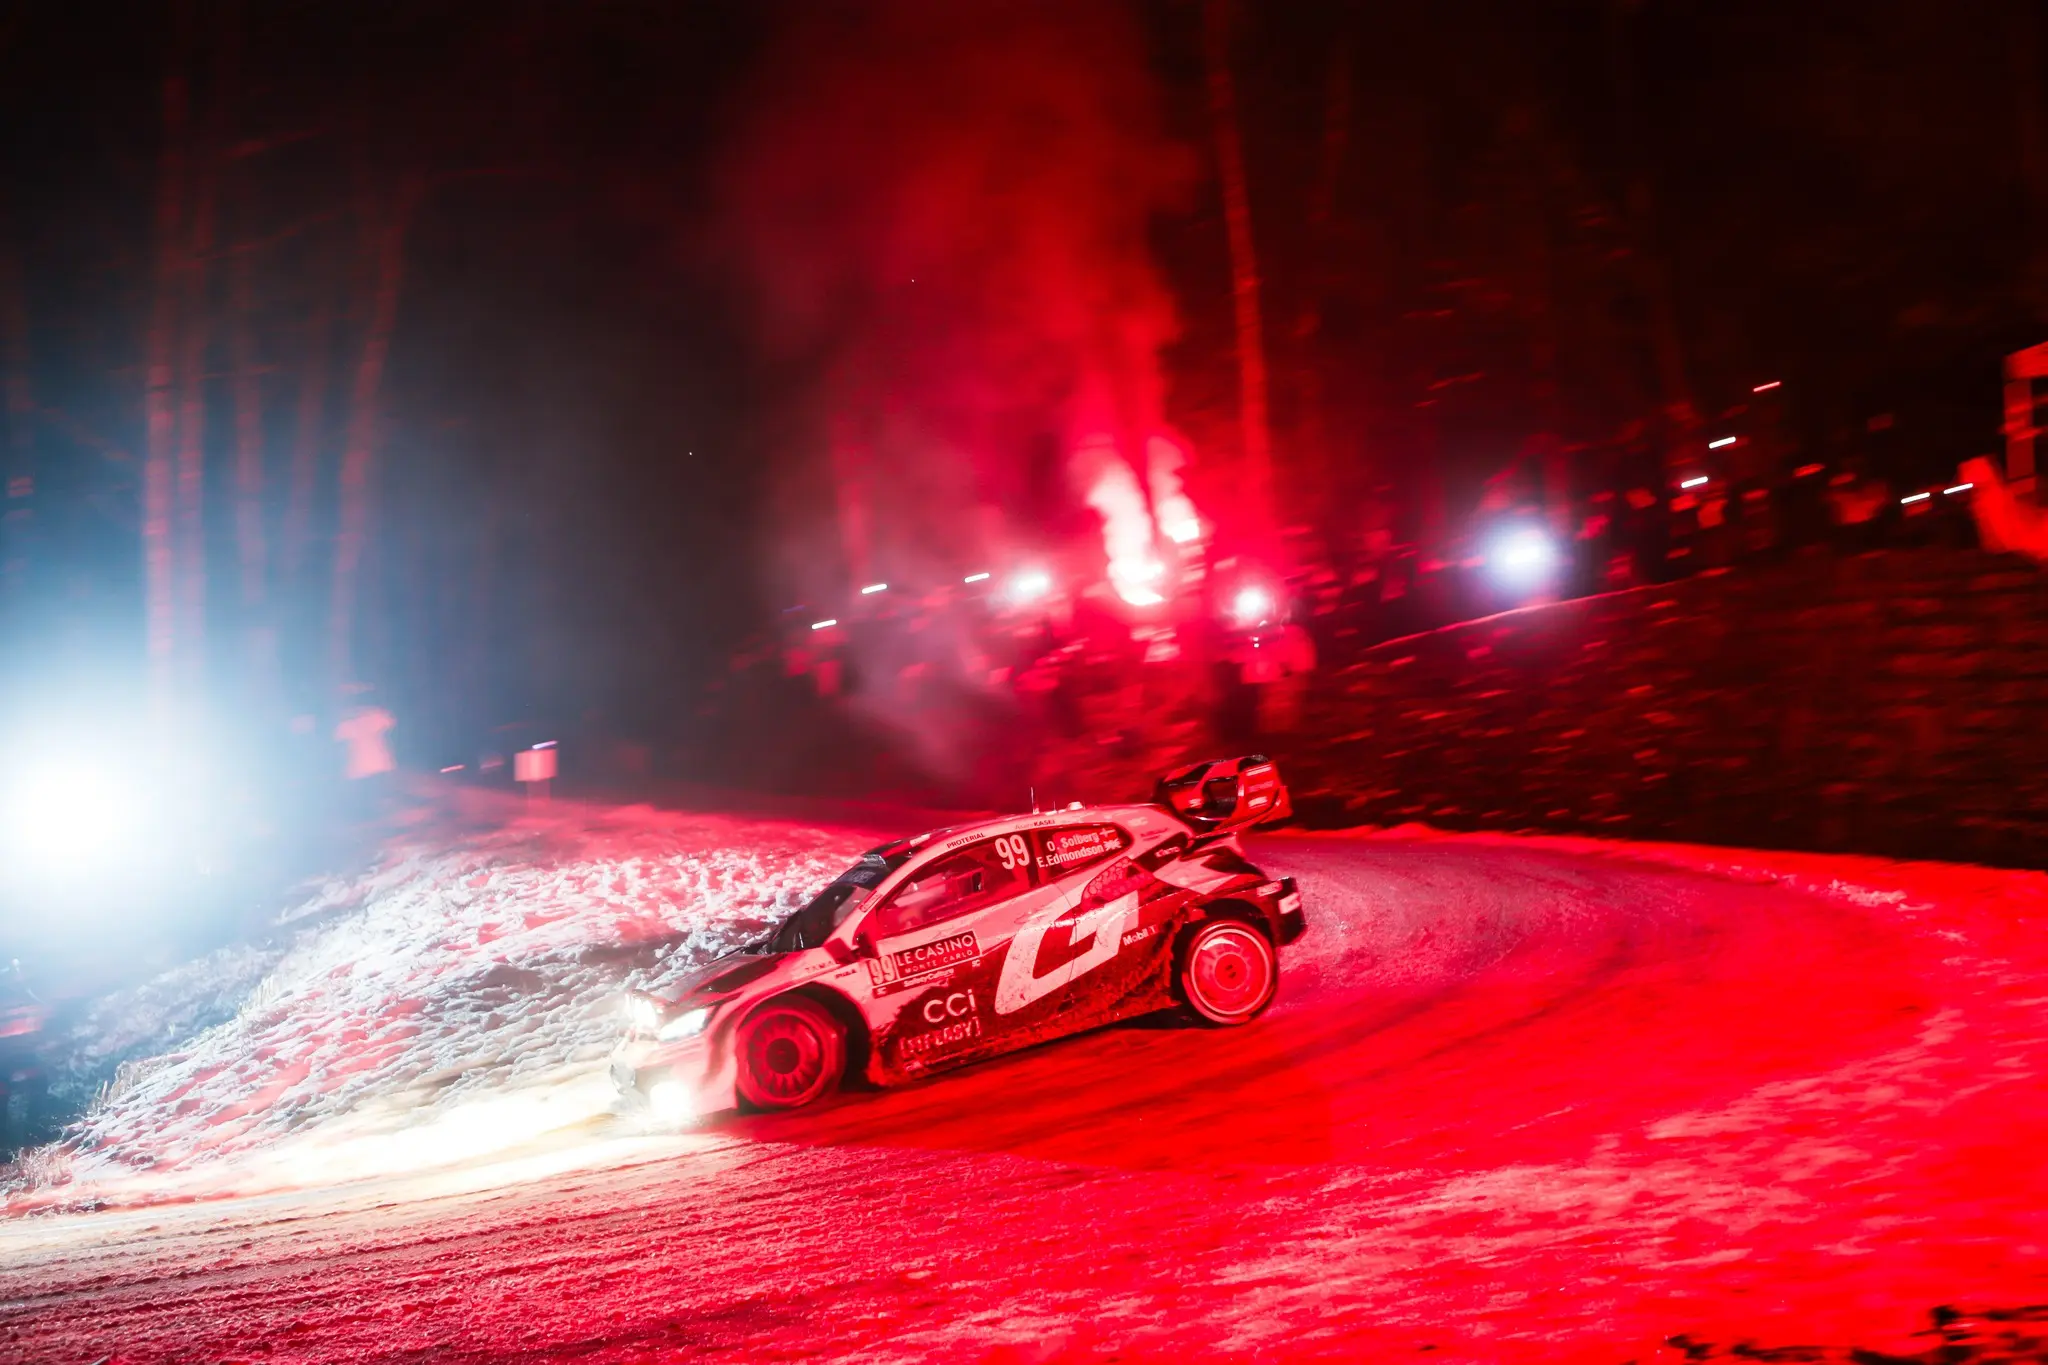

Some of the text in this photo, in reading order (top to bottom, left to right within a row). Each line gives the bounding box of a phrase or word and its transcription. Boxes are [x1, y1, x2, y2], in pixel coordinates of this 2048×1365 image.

[947, 832, 986, 849] PROTERIAL
[994, 834, 1030, 870] 99
[1060, 832, 1100, 848] Solberg
[1036, 844, 1104, 868] E.Edmondson
[1122, 928, 1149, 946] Mobil
[896, 934, 974, 966] LE CASINO
[904, 950, 973, 974] MONTE CARLO
[869, 955, 896, 985] 99
